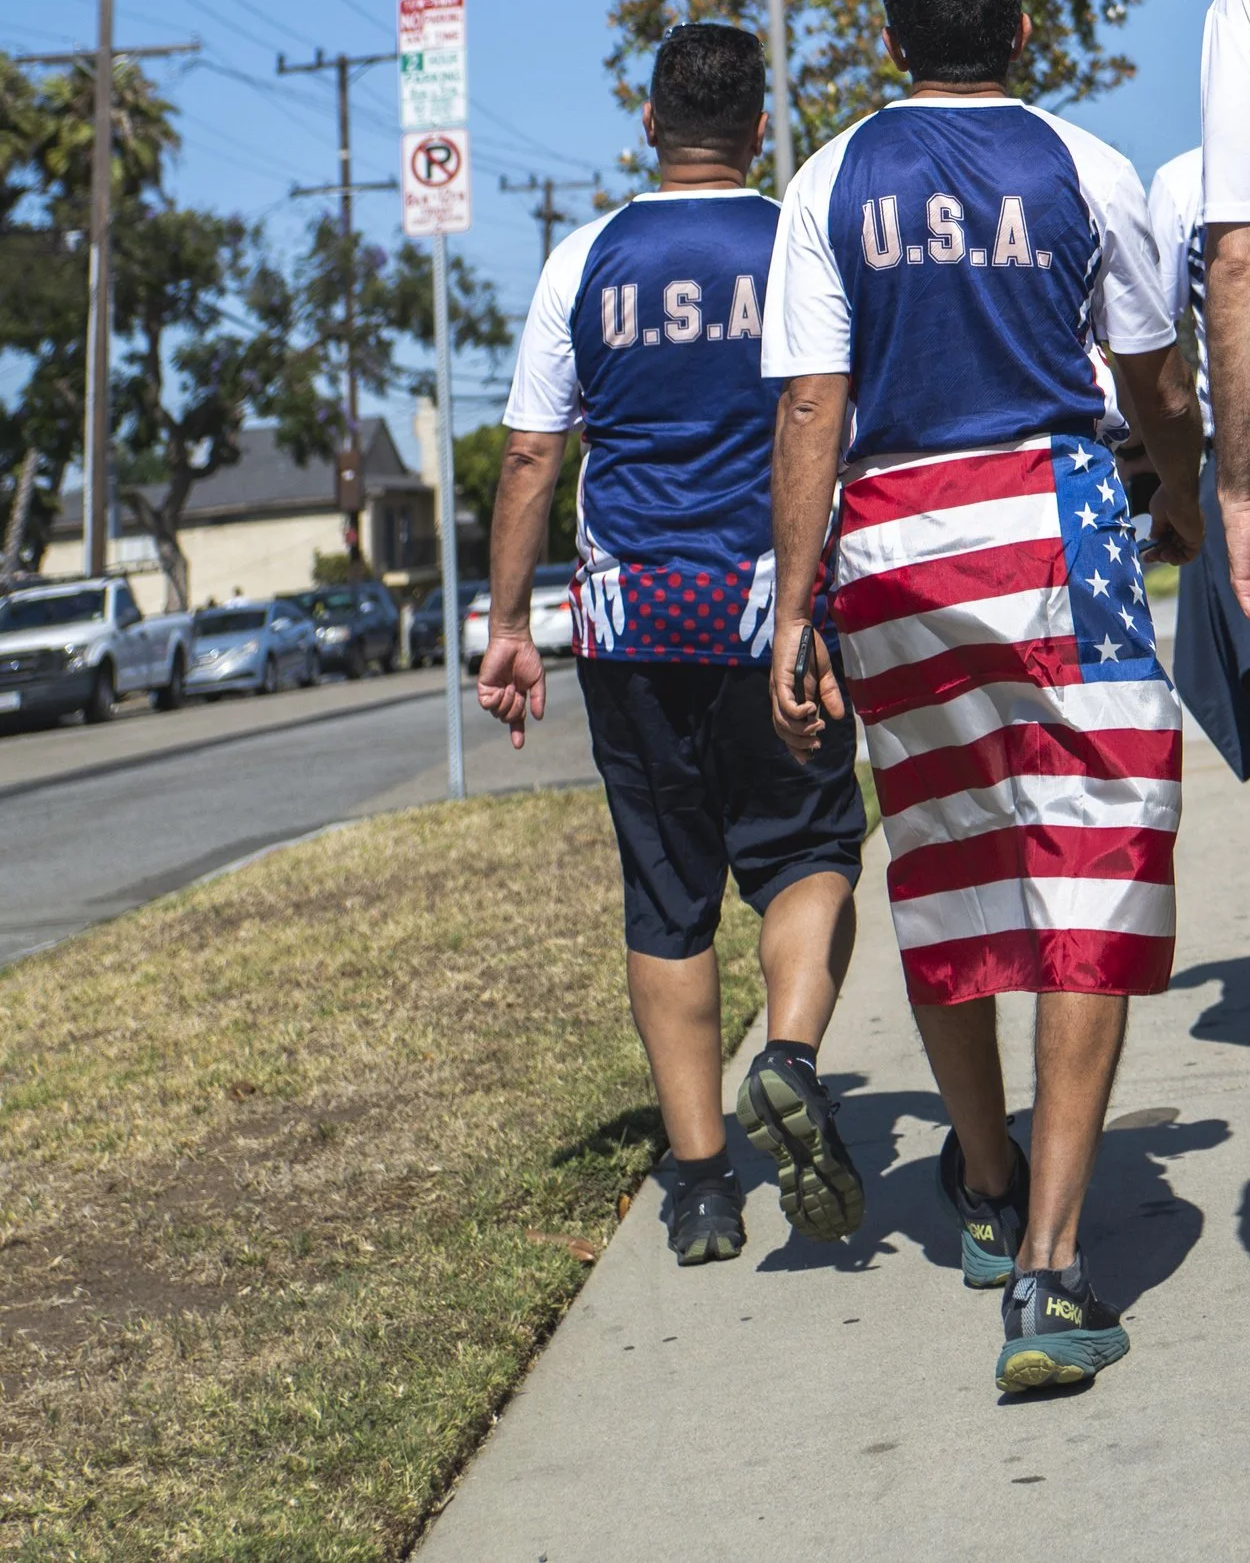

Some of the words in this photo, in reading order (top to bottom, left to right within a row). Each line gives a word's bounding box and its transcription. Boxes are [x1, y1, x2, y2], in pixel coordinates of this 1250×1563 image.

[862, 192, 1053, 271] U.S.A.
[601, 275, 763, 350] U.S.A
[1046, 1296, 1083, 1328] HOKA
